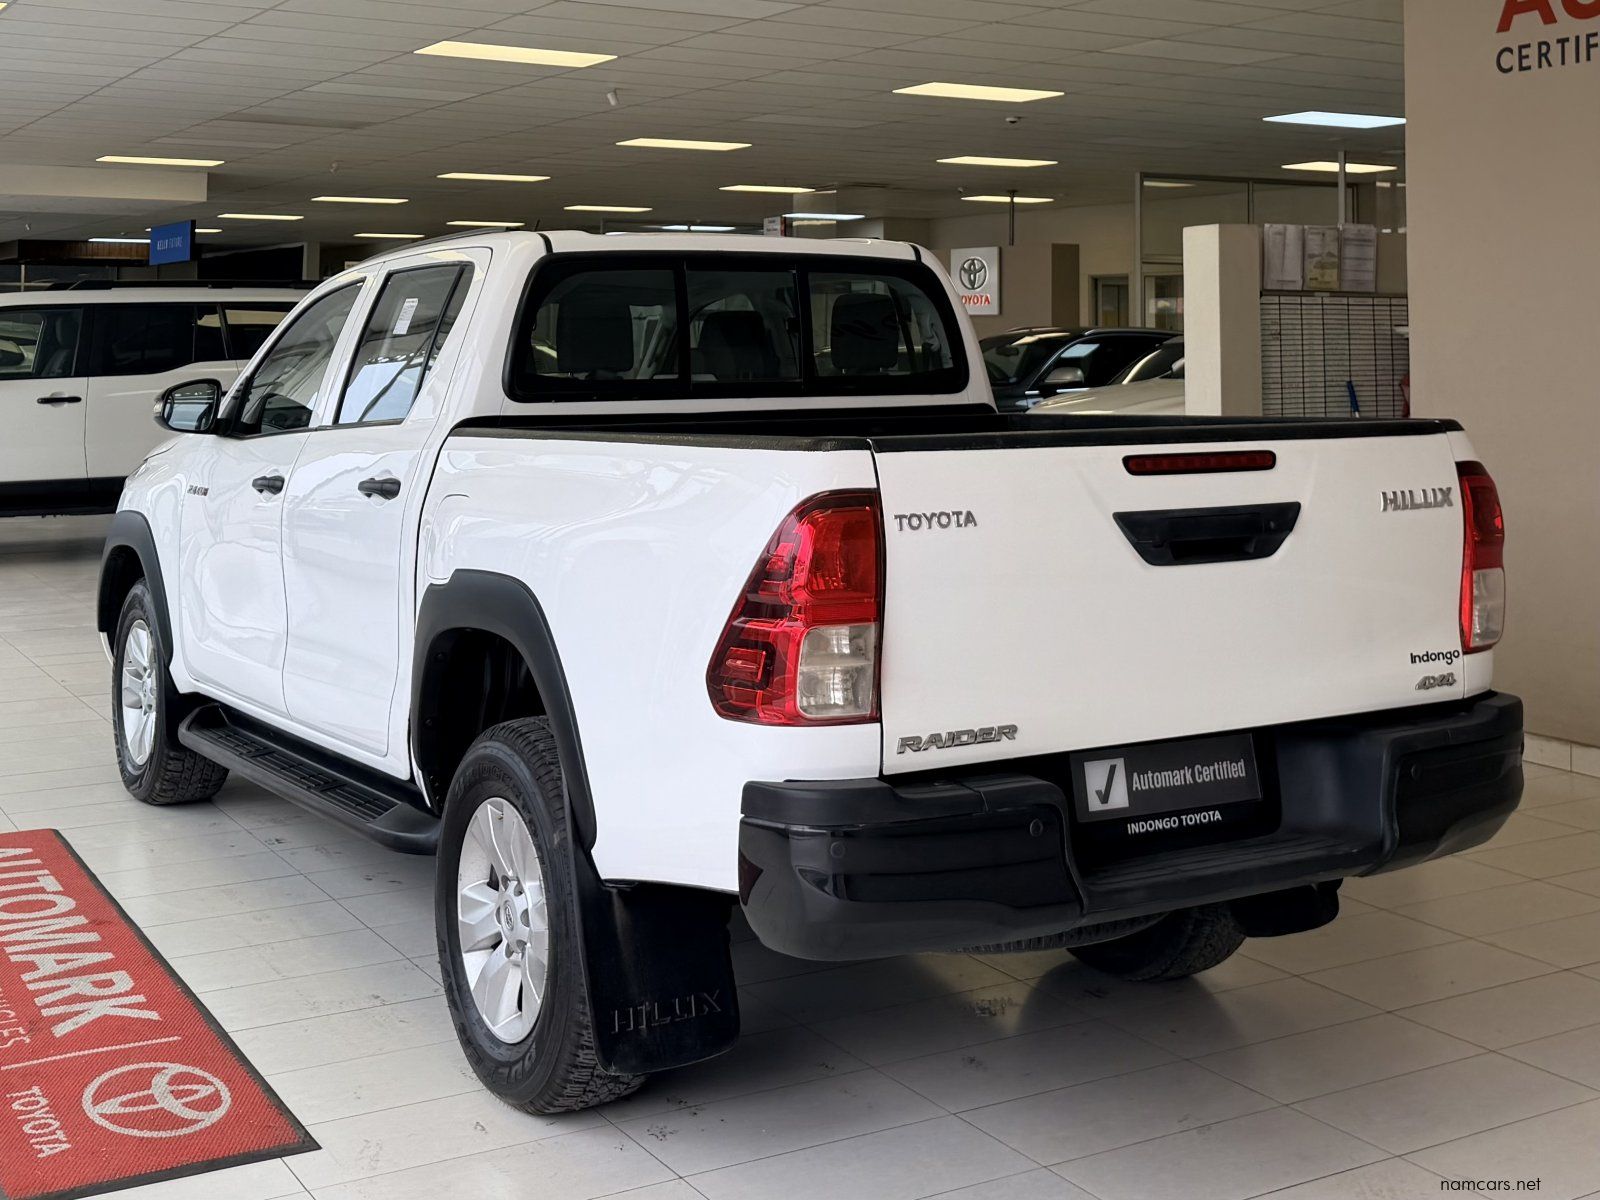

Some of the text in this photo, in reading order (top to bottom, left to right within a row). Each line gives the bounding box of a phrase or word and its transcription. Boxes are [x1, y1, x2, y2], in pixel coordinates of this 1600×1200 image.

[961, 294, 991, 305] OYOTA
[1380, 487, 1453, 512] HILUX
[894, 510, 977, 531] TOYOTA
[1410, 650, 1460, 665] Indongo
[897, 724, 1018, 754] RAIDER
[1132, 758, 1246, 791] Automark Certified
[1127, 810, 1222, 834] INDONGO TOYOTA
[611, 989, 722, 1034] HILUX
[5, 1085, 72, 1158] TOYOTA
